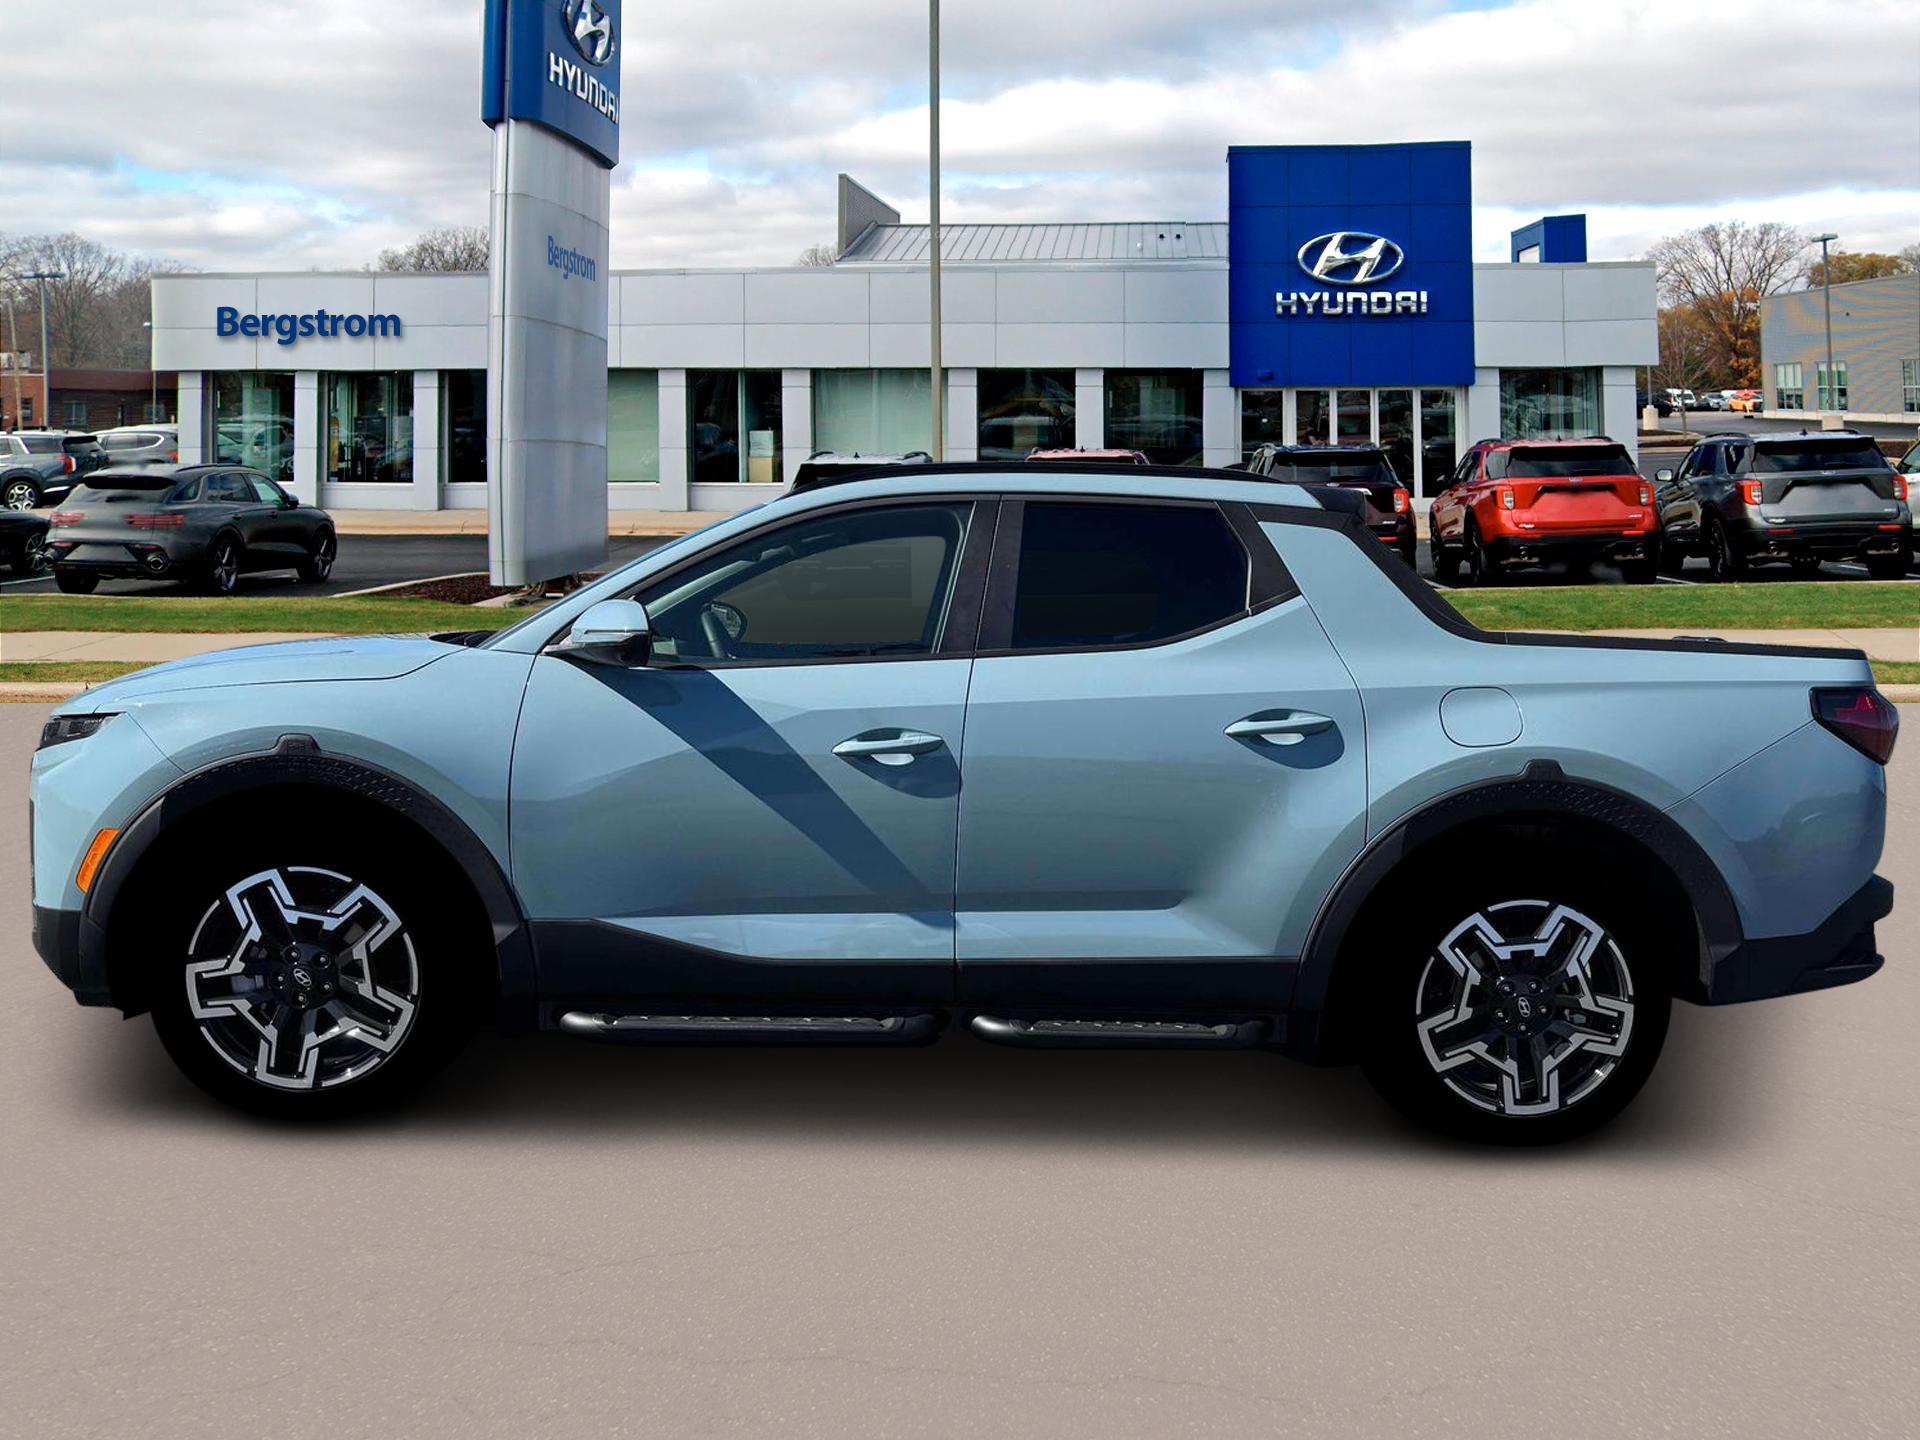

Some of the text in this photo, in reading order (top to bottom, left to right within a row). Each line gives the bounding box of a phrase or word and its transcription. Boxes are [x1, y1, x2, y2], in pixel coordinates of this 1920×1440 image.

[549, 51, 619, 124] HYUNDAI
[547, 235, 596, 282] Bergstrom
[1275, 290, 1428, 316] HYUNDAI
[216, 306, 402, 346] Bergstrom
